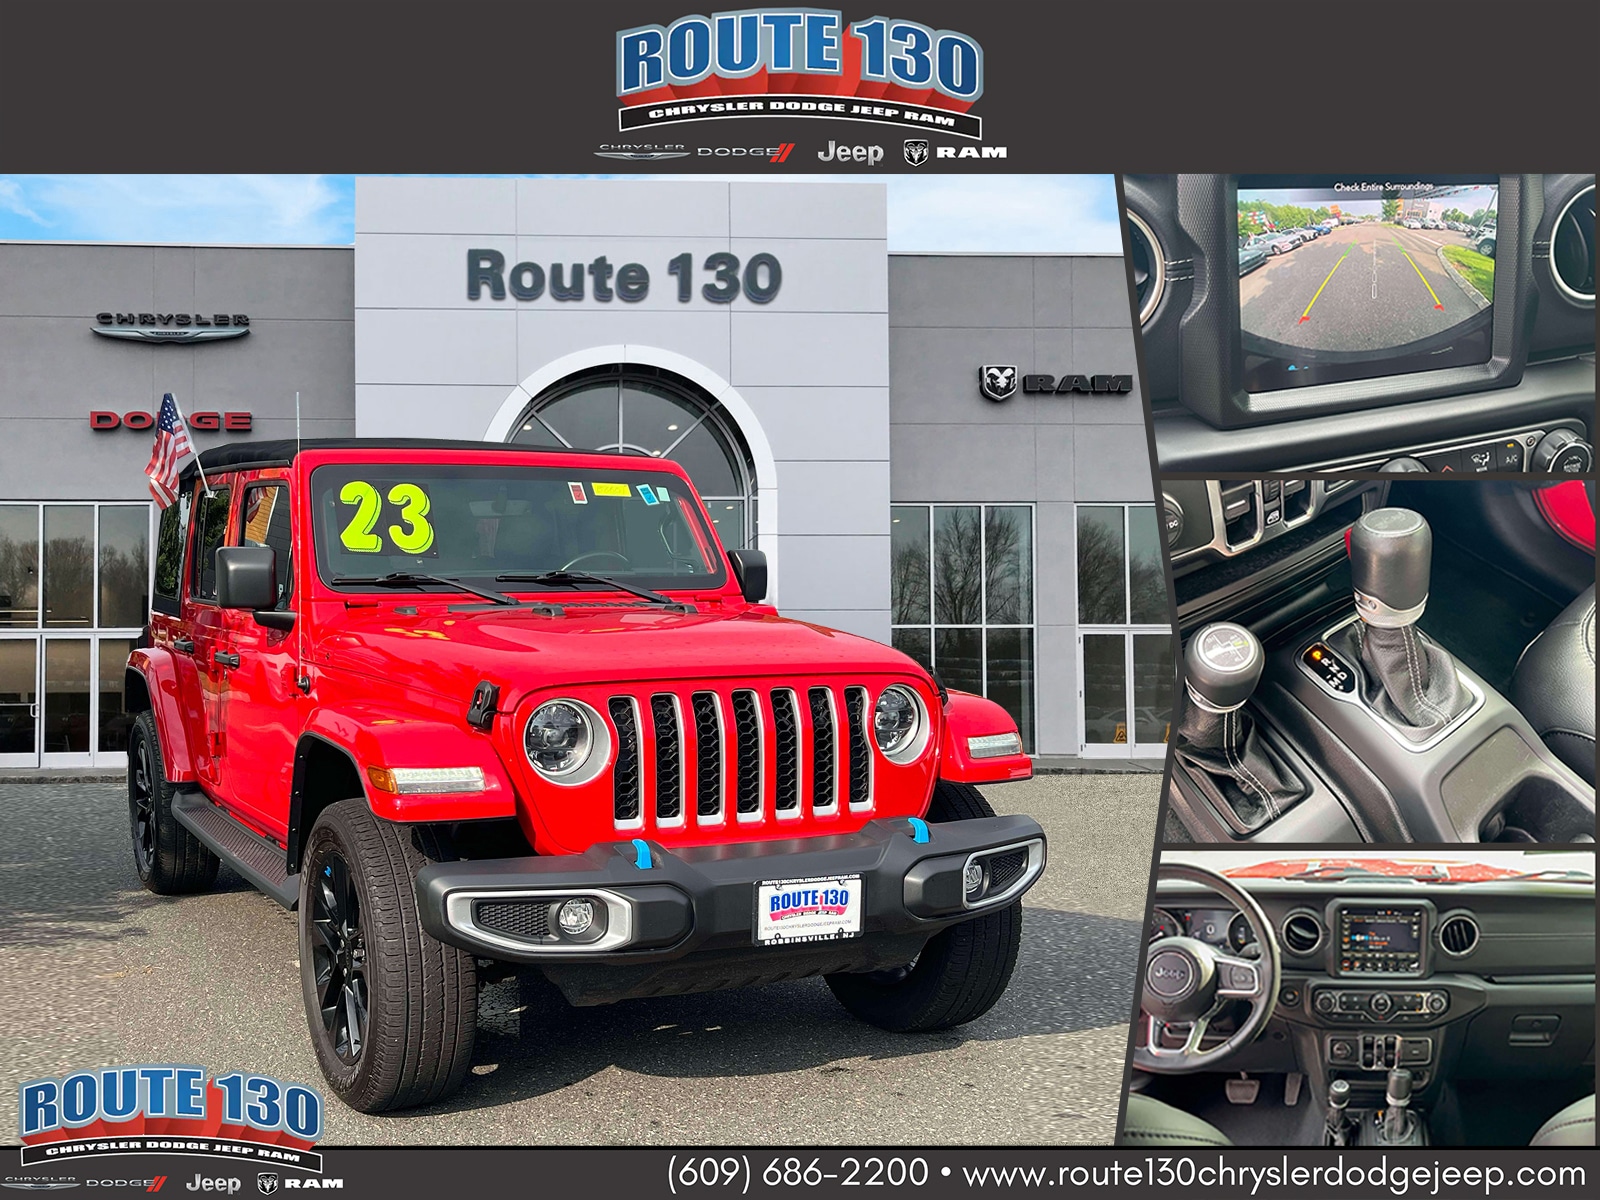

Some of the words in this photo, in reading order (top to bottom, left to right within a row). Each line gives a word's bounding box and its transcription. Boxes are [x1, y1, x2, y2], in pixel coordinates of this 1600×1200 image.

[1334, 182, 1360, 192] Check
[1361, 182, 1384, 192] Entire
[1385, 181, 1434, 192] Surroundings
[467, 248, 650, 301] Route
[668, 251, 782, 303] 130
[96, 312, 250, 326] CHRYSLER
[1023, 374, 1133, 394] RAM
[90, 410, 252, 430] DOGE
[339, 480, 435, 554] 23
[1311, 650, 1322, 660] P
[1320, 657, 1331, 667] R
[1337, 671, 1348, 681] D
[770, 889, 819, 912] ROUTE
[822, 889, 849, 906] 130
